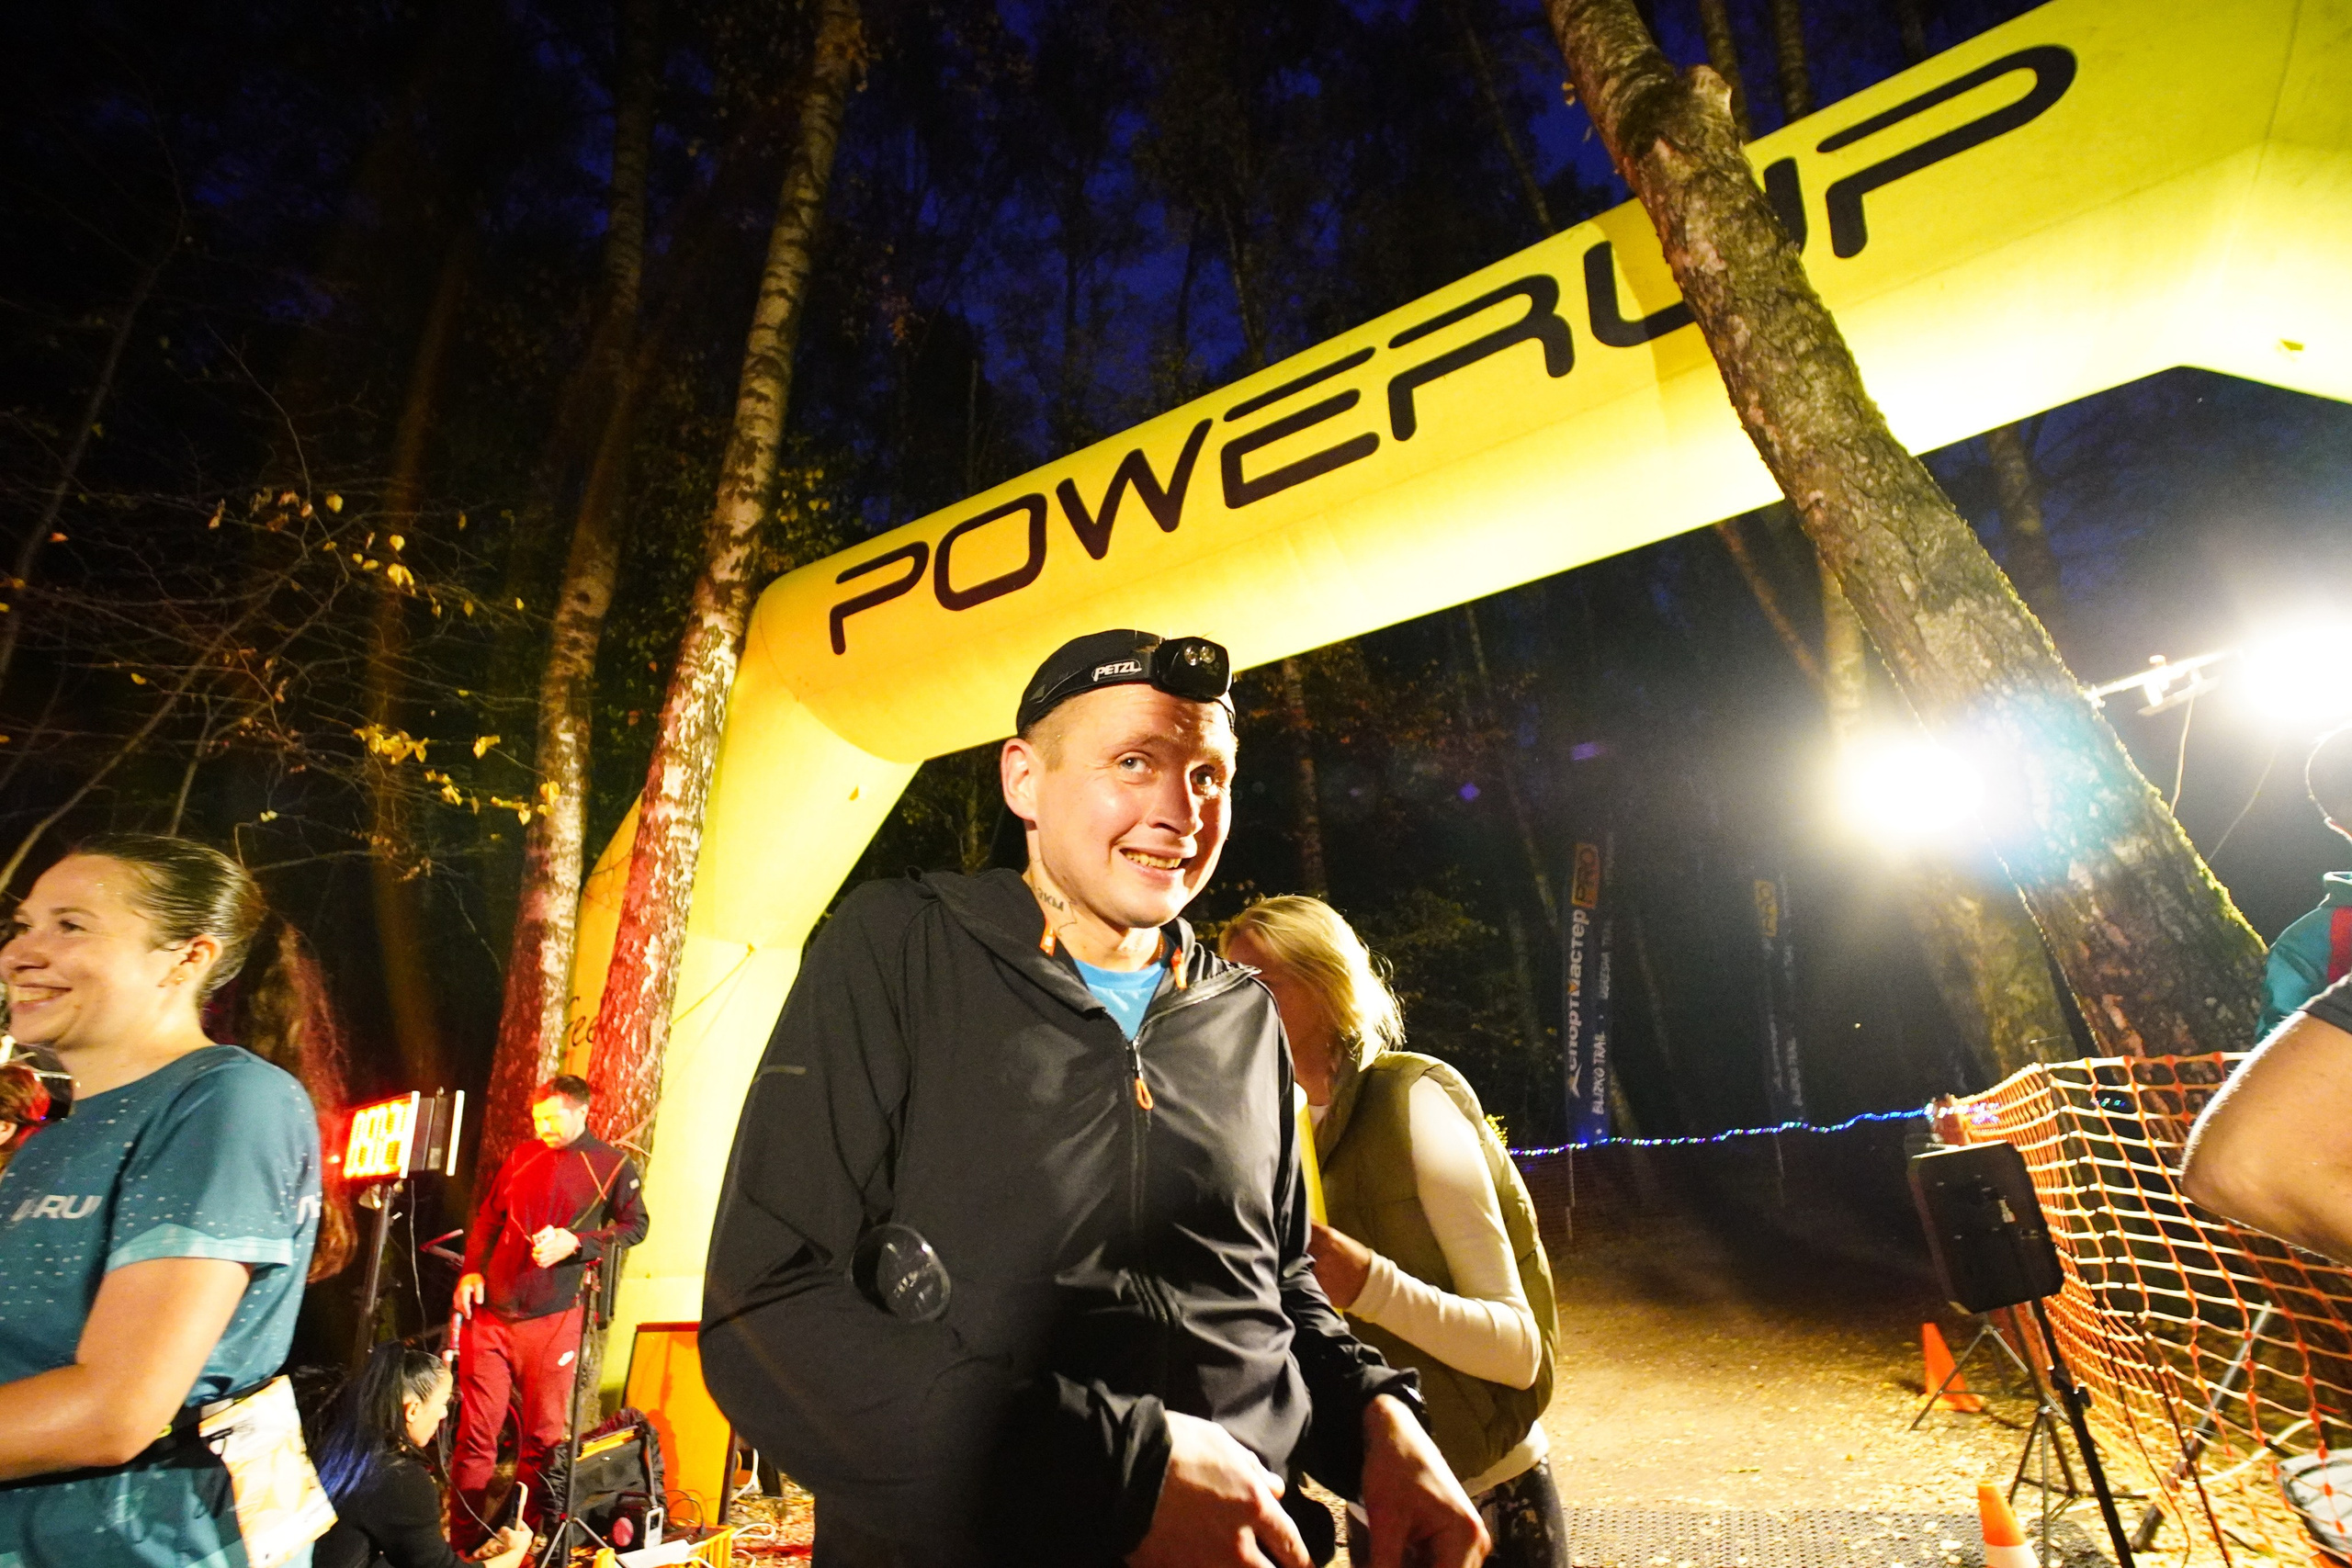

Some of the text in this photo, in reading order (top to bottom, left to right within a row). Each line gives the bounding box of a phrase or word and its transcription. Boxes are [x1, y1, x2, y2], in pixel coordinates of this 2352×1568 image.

[829, 43, 2078, 655] POWERUP
[1092, 660, 1143, 682] PETZL
[1573, 847, 1597, 904] PRO
[1593, 1031, 1607, 1065] TRAIL
